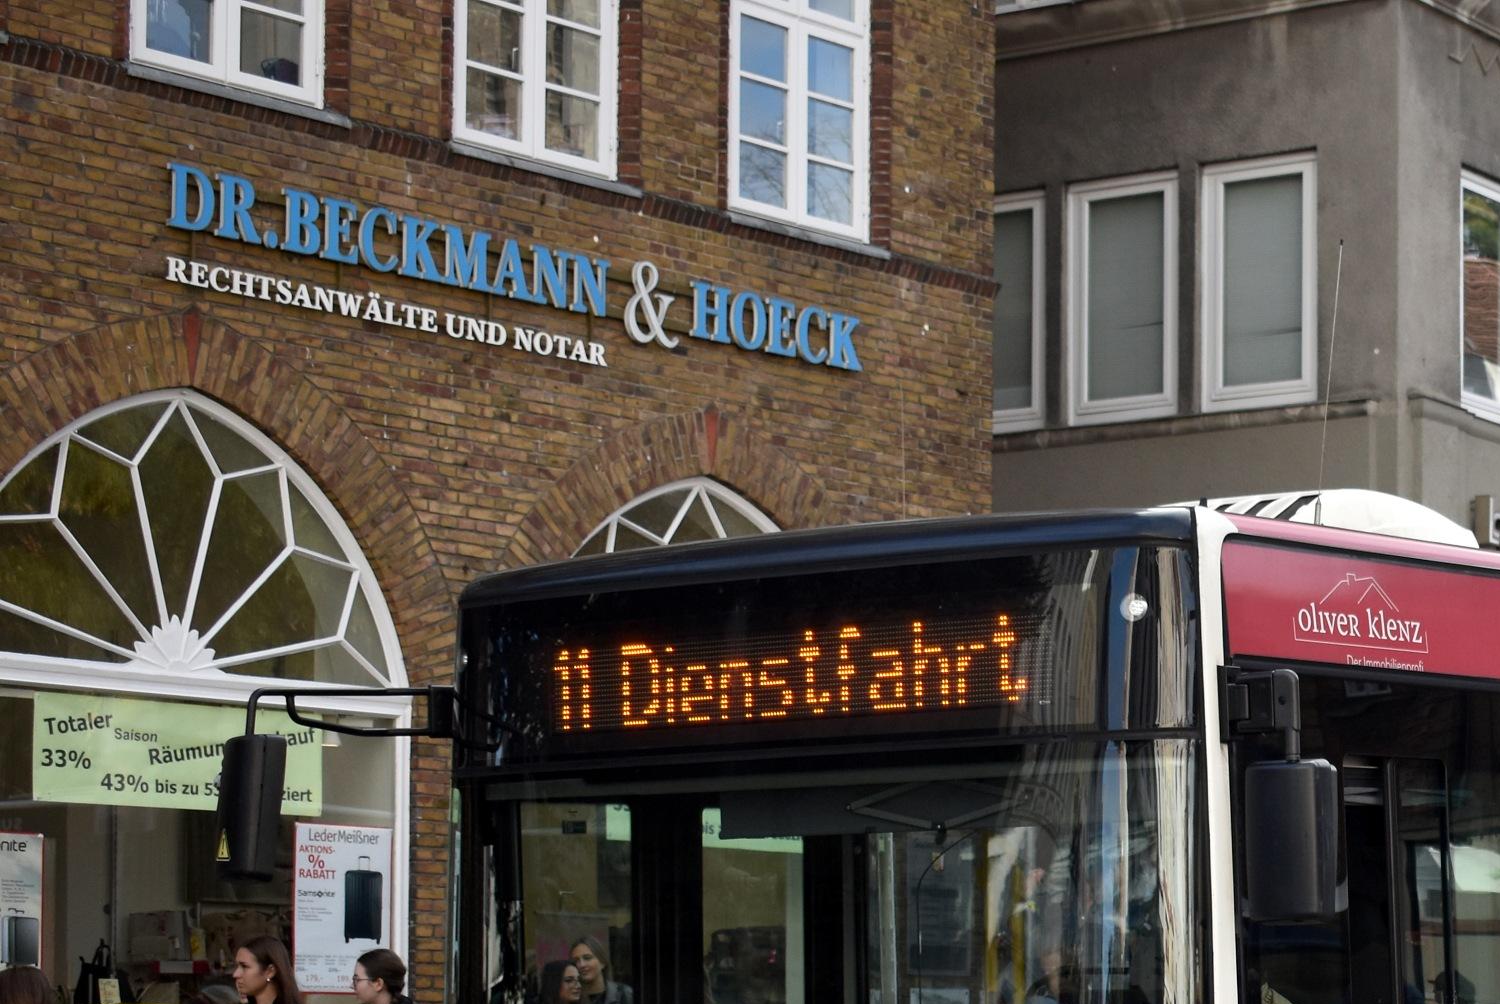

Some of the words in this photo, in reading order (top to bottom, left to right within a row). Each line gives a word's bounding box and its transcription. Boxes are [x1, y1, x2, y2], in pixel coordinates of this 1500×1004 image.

[166, 256, 438, 332] RECHTSANWÄLTE
[445, 312, 507, 347] UND
[513, 327, 608, 367] NOTAR
[624, 261, 679, 349] &
[689, 280, 863, 372] HOECK
[553, 649, 592, 731] 11
[620, 615, 1028, 727] Dienstfahrt
[43, 712, 113, 736] Totaler
[114, 727, 158, 742] Saison
[41, 748, 91, 770] 33%
[100, 773, 149, 793] 43%
[155, 779, 177, 795] bis
[181, 784, 199, 796] zu
[299, 844, 335, 855] AKTIONS-
[308, 854, 325, 869] %
[299, 869, 336, 880] RABATT
